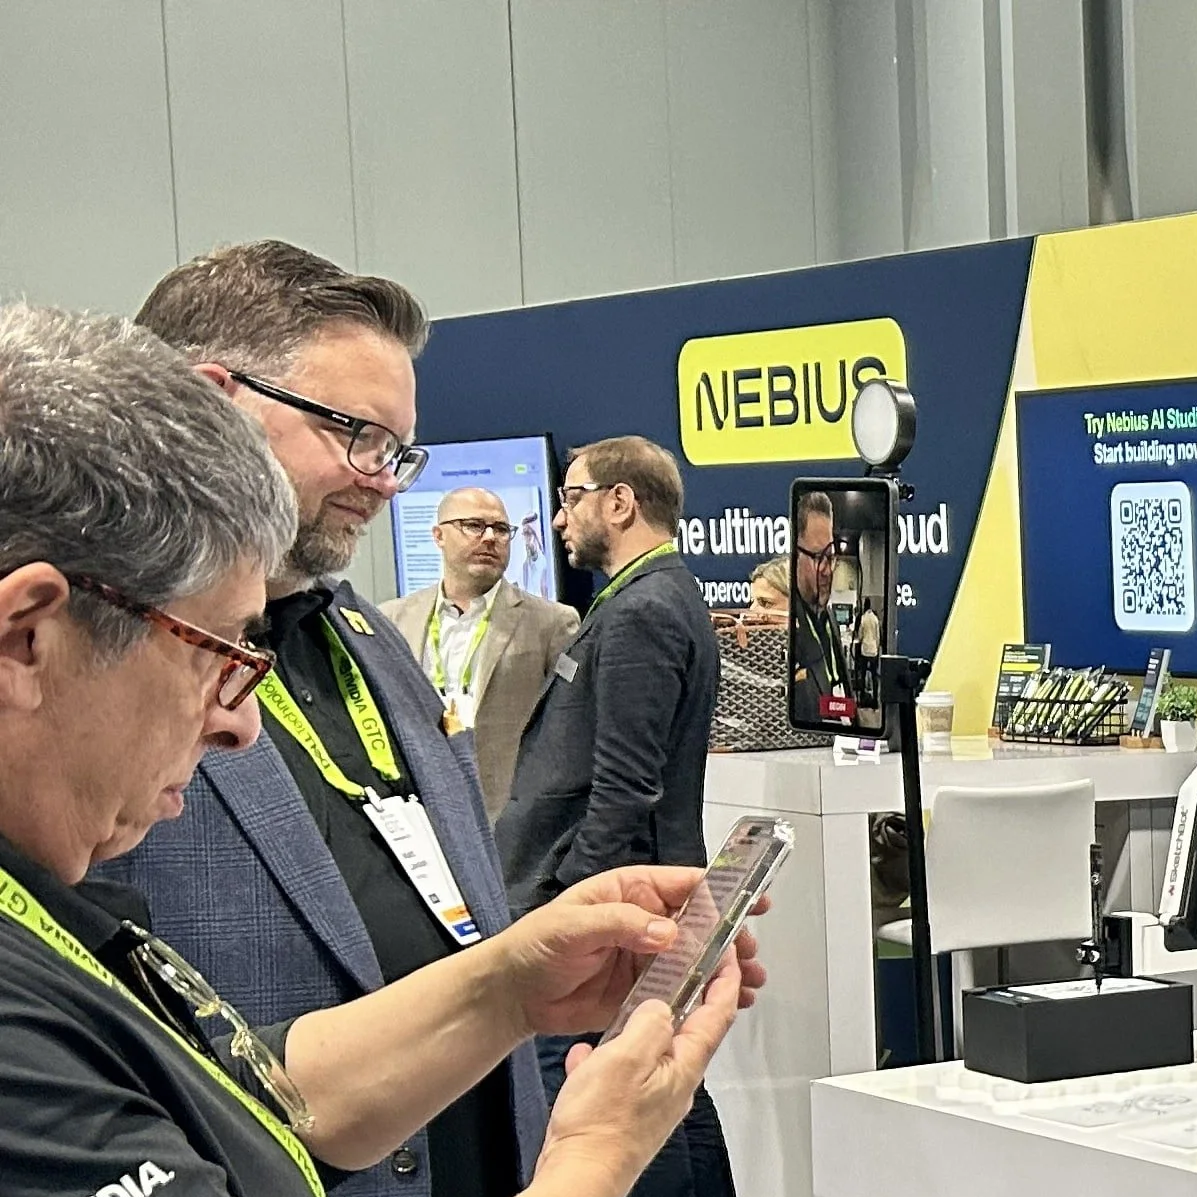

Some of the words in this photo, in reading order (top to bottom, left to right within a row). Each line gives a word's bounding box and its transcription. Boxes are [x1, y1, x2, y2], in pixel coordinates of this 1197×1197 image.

[1084, 413, 1104, 439] Try
[1106, 411, 1149, 433] Nebius
[1150, 408, 1164, 430] AI
[1094, 442, 1123, 464] Start
[1125, 440, 1174, 465] building
[361, 717, 386, 752] GTC
